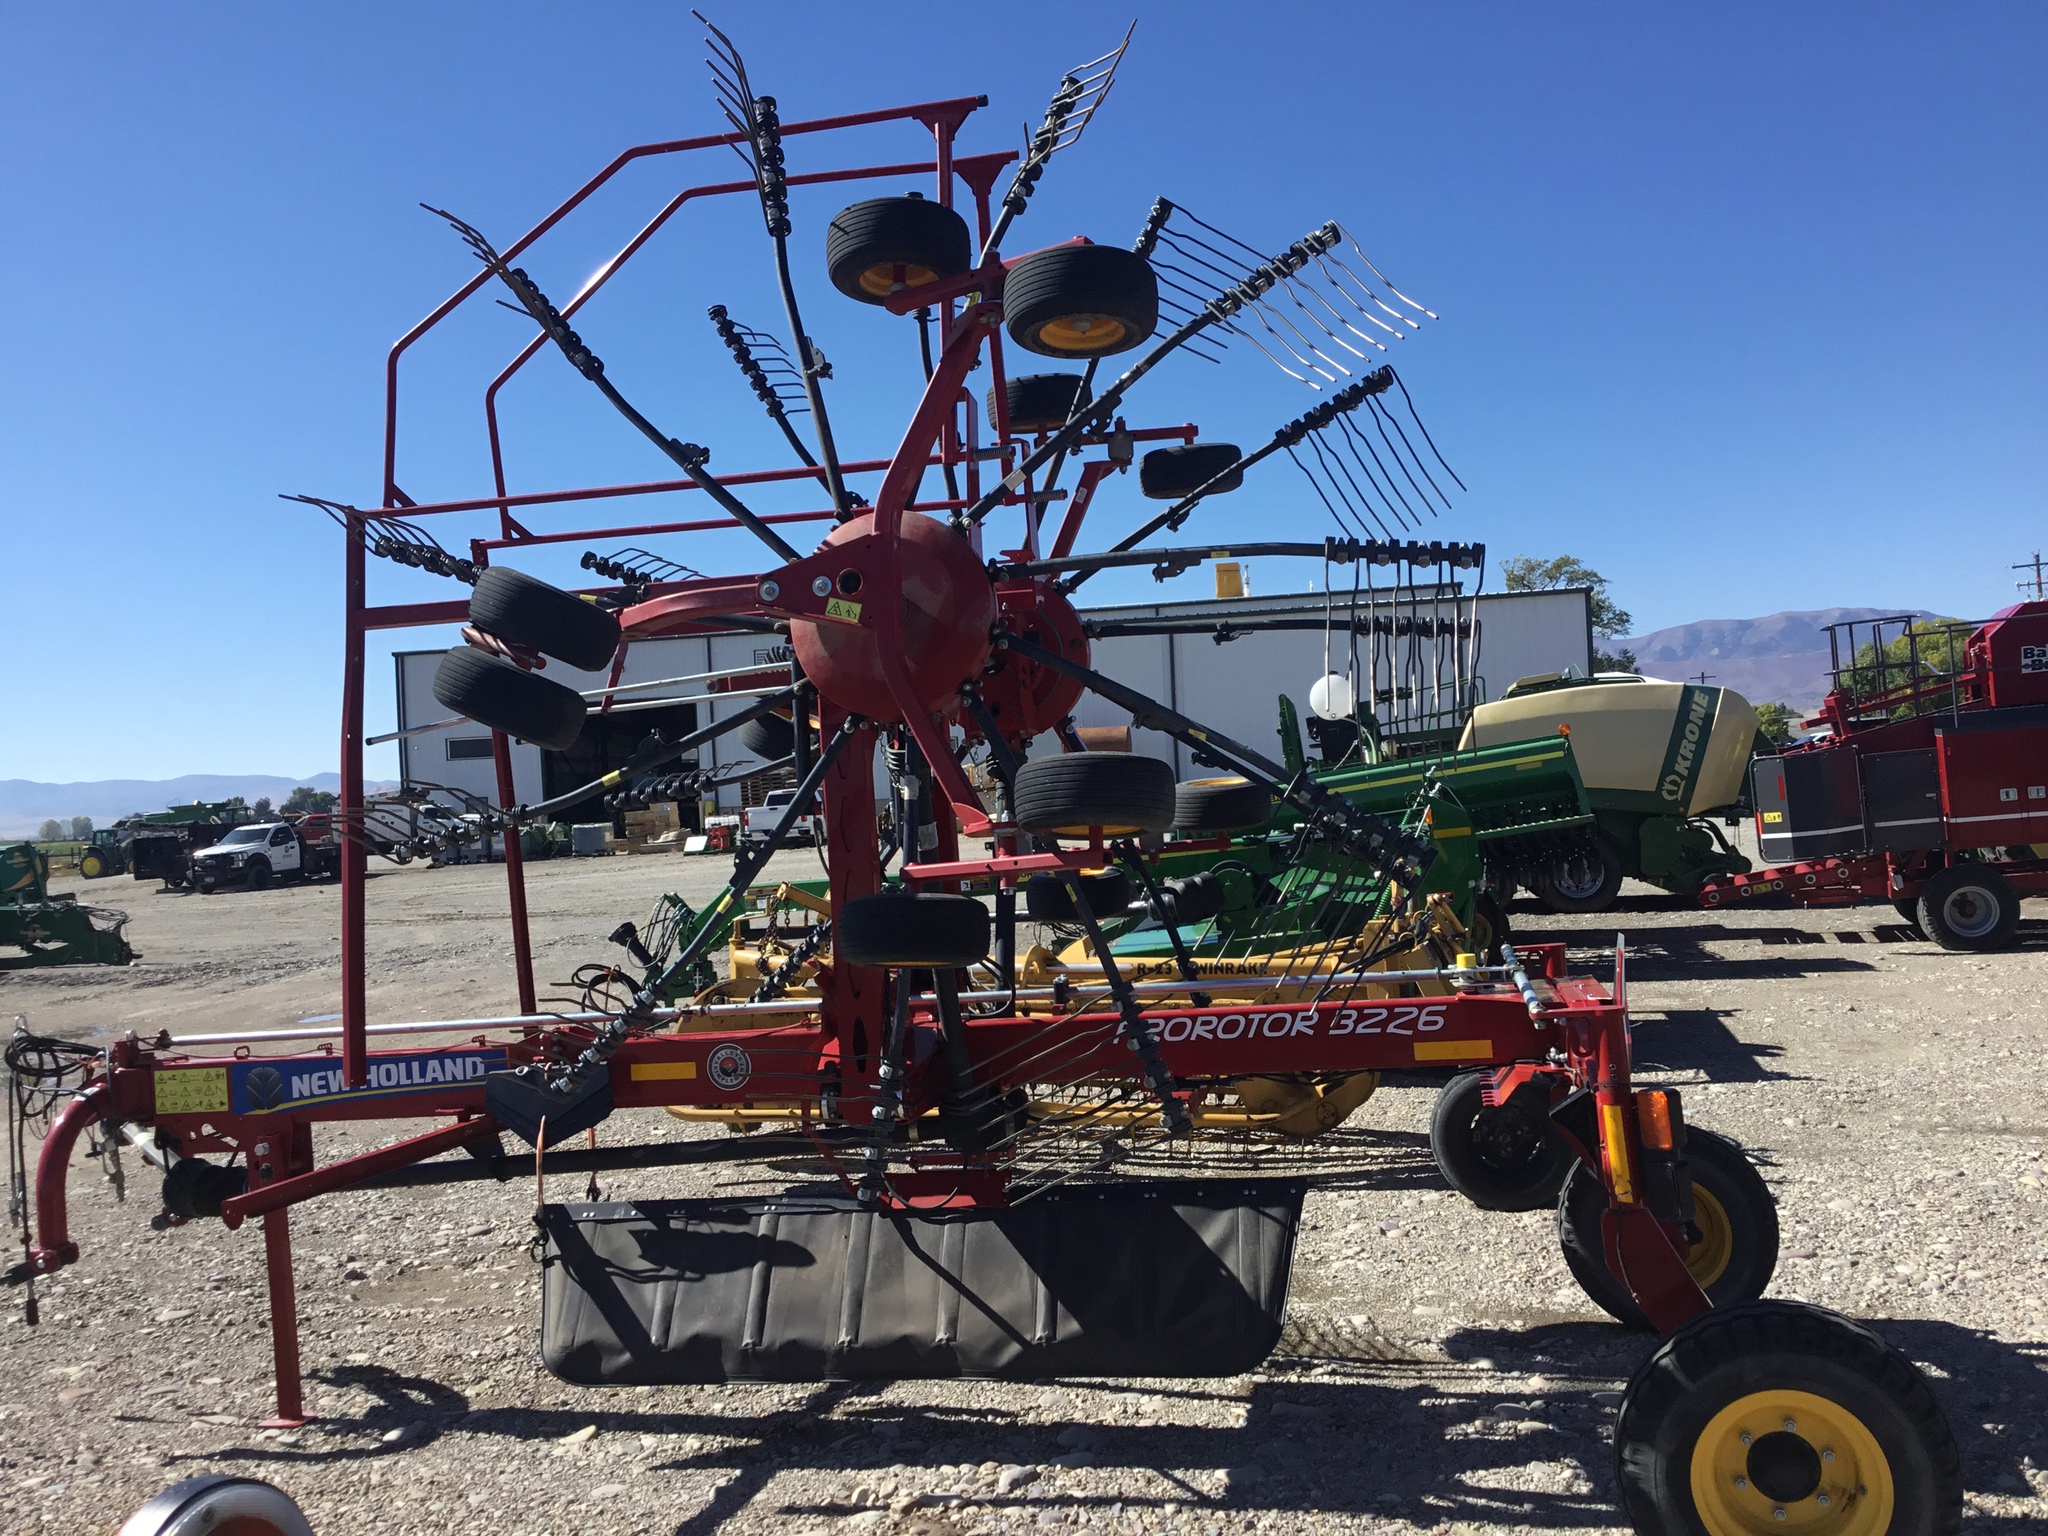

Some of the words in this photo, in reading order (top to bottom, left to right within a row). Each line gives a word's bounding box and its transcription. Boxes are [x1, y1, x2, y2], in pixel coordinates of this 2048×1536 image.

[2023, 647, 2048, 660] Ba
[1674, 689, 1709, 777] KRONE
[1197, 962, 1267, 975] WINRAKE
[1328, 1005, 1447, 1036] 3226
[291, 1068, 350, 1099] NEW
[359, 1056, 485, 1089] HOLLAND
